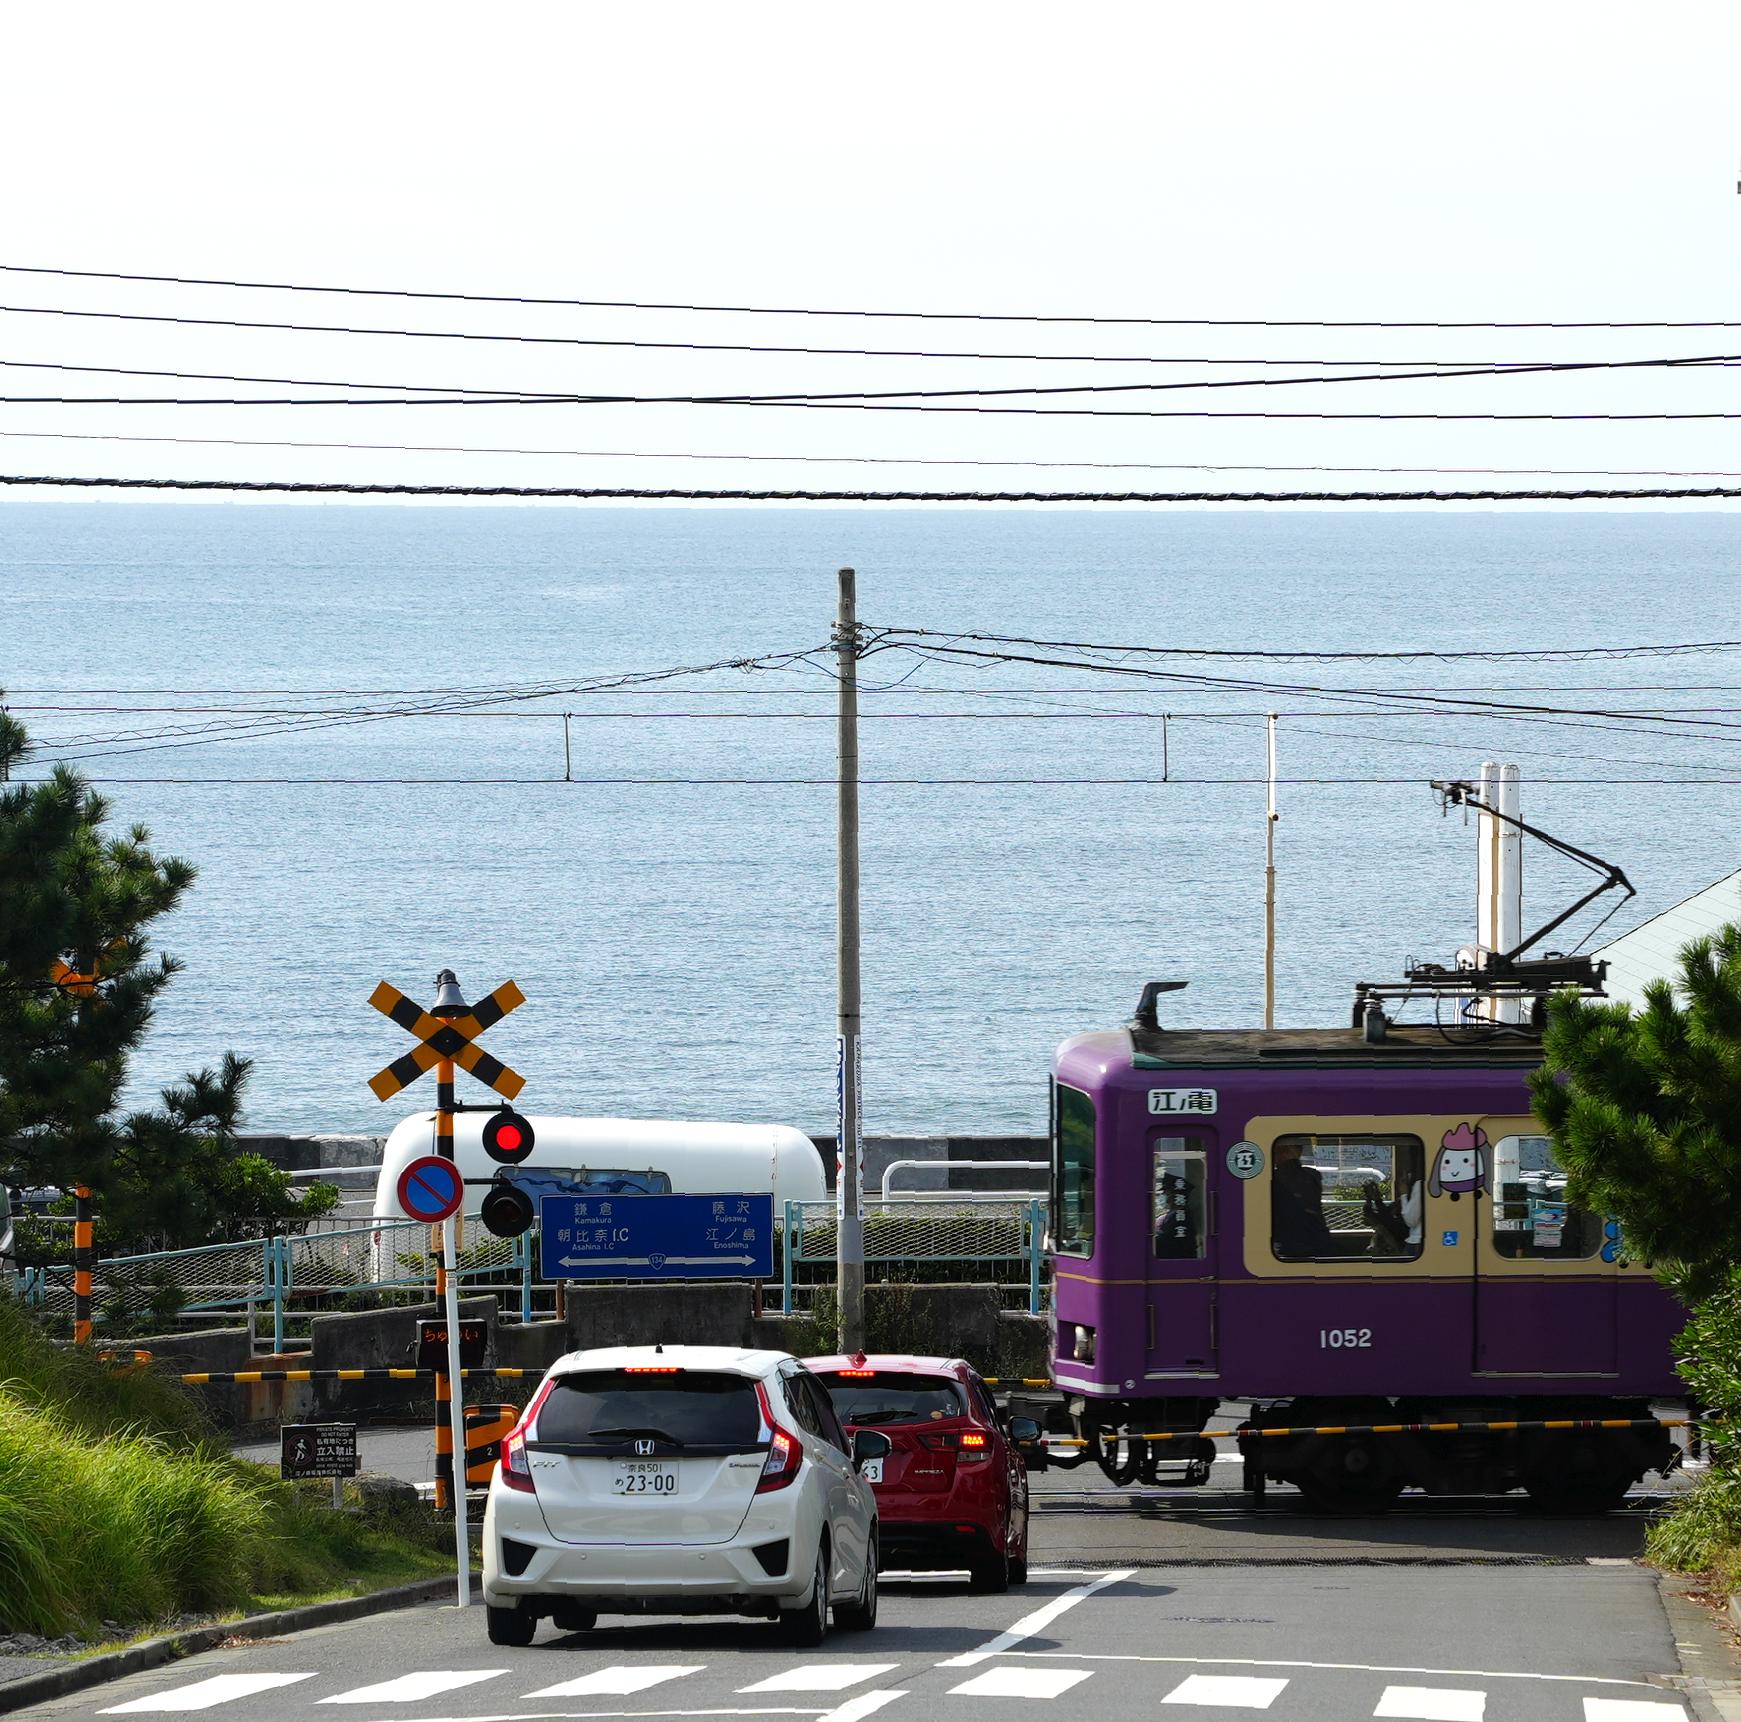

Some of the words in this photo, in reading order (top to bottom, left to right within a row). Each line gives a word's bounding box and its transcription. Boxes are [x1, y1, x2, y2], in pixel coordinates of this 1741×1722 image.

[1153, 1091, 1213, 1112] 江ノ電
[574, 1201, 613, 1217] 鎌倉
[712, 1201, 750, 1215] 藤沢
[574, 1217, 612, 1225] Kamakura
[715, 1215, 747, 1224] Fujisawa
[705, 1227, 756, 1242] 江ノ島
[572, 1243, 601, 1251] Asahina
[713, 1241, 749, 1250] Enoshima
[650, 1256, 664, 1265] 134
[1320, 1328, 1372, 1349] 1052
[316, 1446, 354, 1456] 立入禁止
[486, 1446, 493, 1456] 2
[626, 1474, 675, 1492] 23-00
